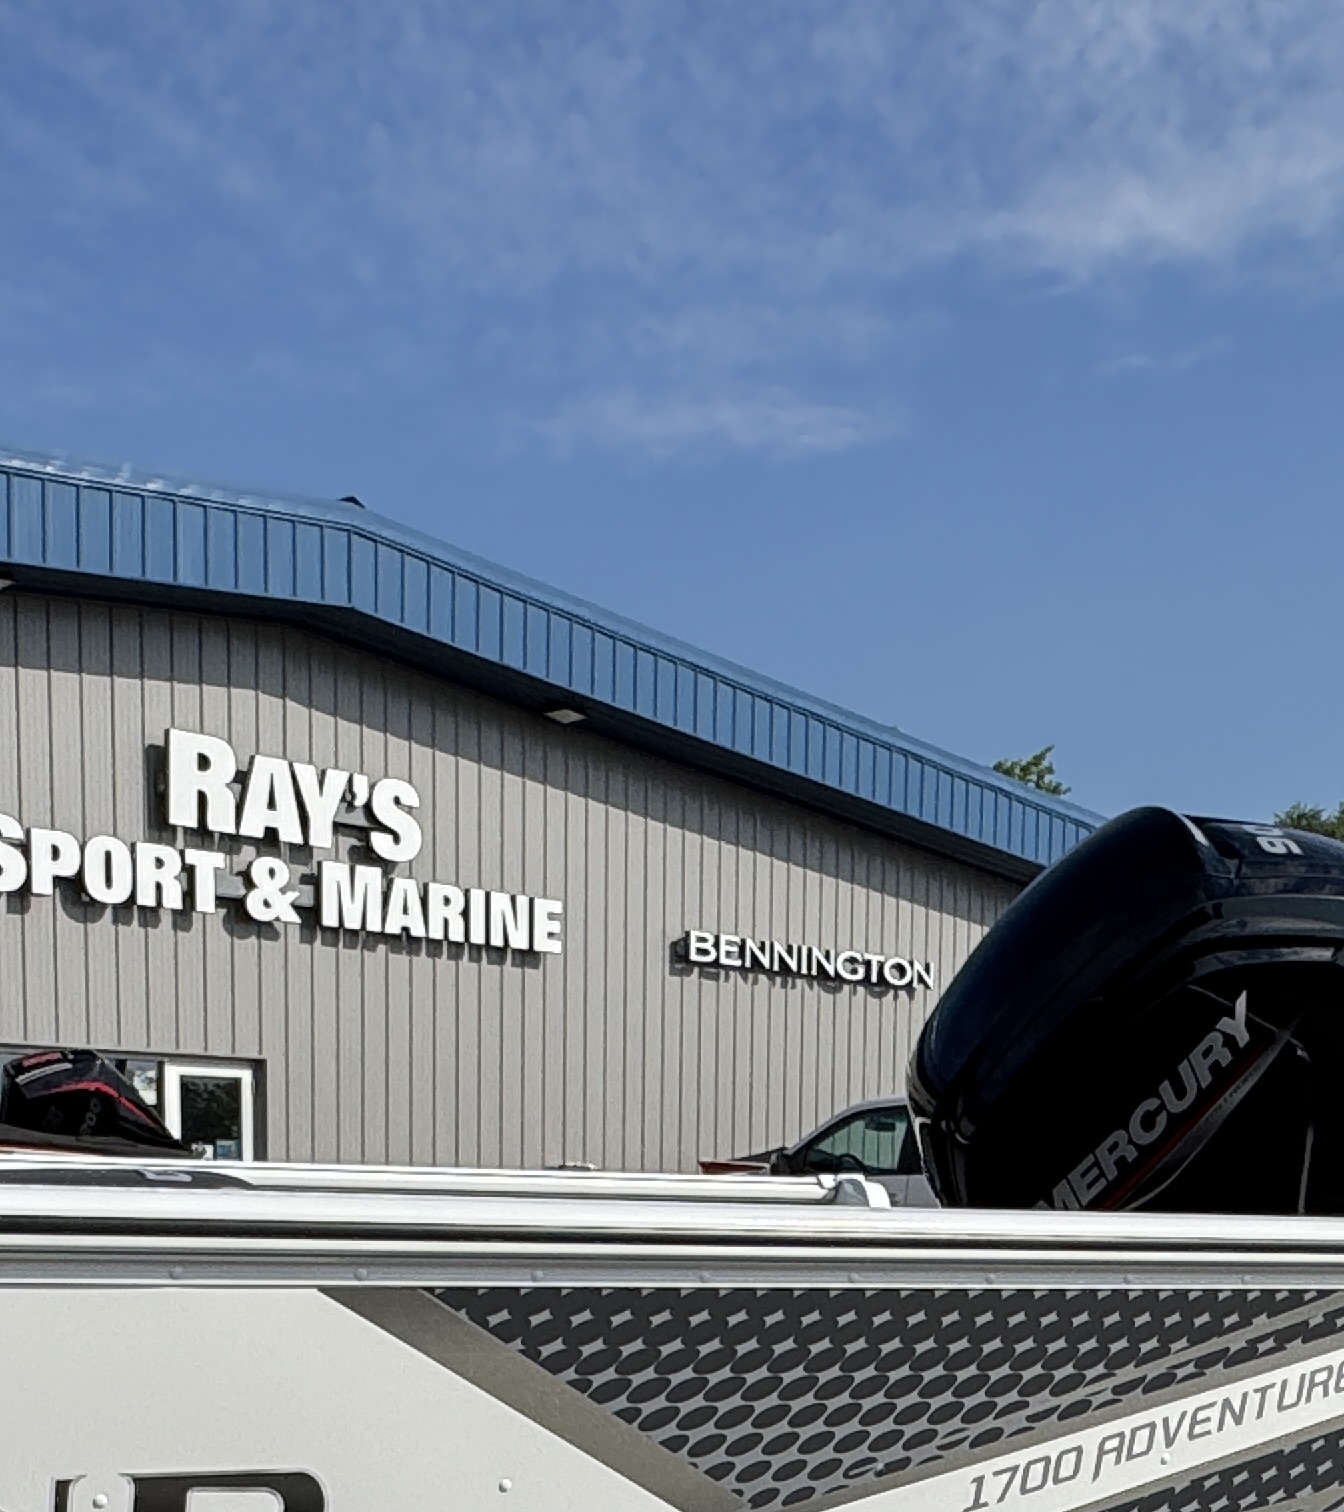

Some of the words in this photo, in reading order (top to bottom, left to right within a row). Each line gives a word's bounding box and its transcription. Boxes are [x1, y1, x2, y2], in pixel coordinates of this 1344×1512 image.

[165, 728, 423, 863] RAY'S
[244, 856, 302, 924] &
[317, 860, 563, 954] MARINE
[688, 929, 935, 991] BENNINGTON
[1032, 989, 1251, 1210] MERCURY
